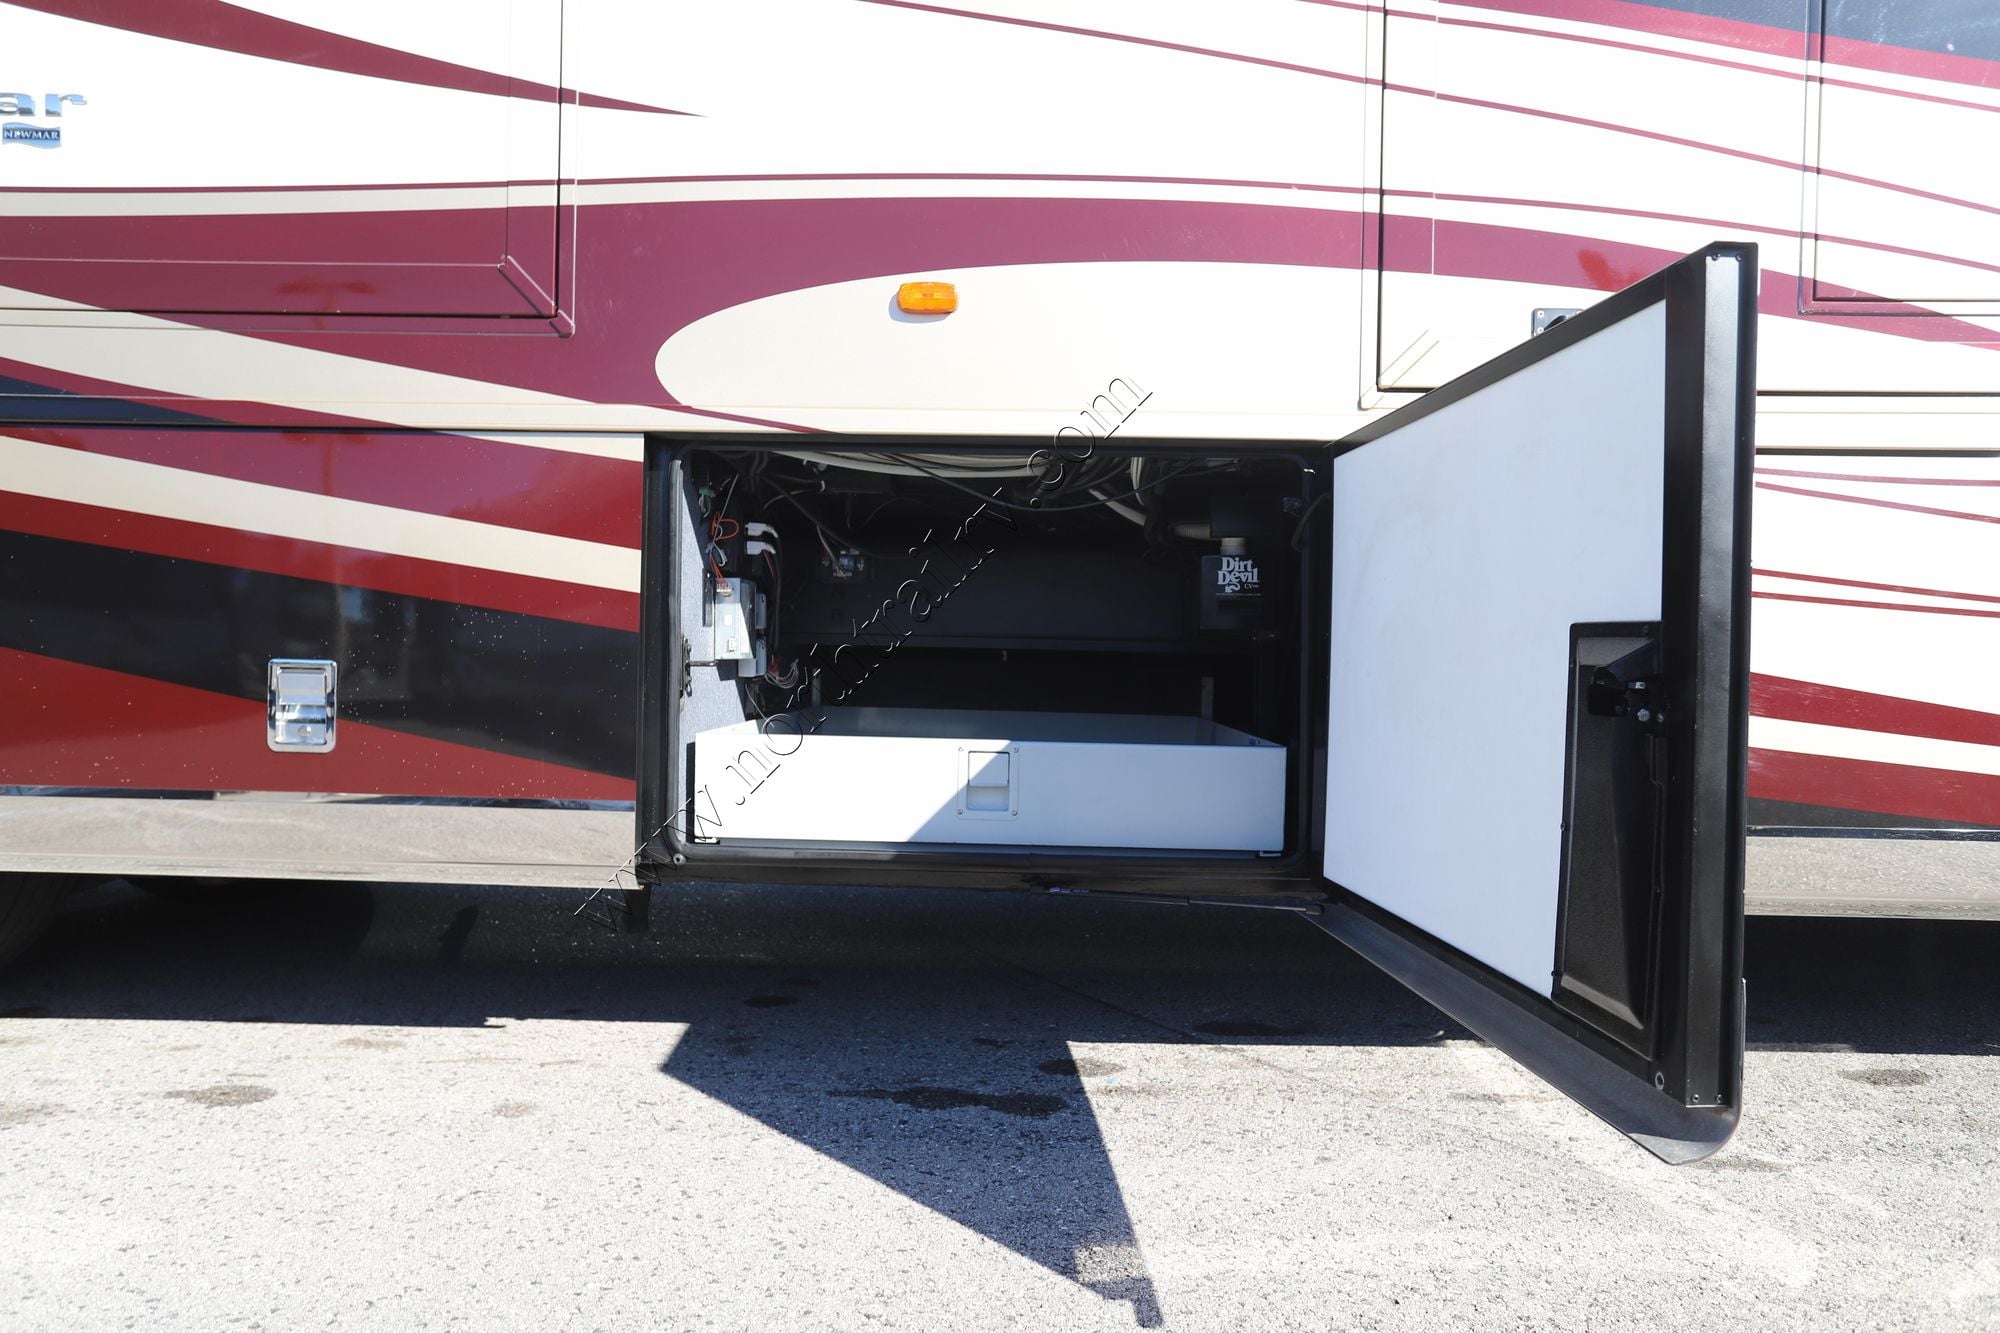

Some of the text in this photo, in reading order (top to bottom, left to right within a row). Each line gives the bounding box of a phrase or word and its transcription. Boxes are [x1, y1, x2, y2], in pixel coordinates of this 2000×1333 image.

[4, 129, 59, 140] NEWMAR
[1221, 556, 1253, 572] Dirt
[1217, 567, 1260, 585] Devil
